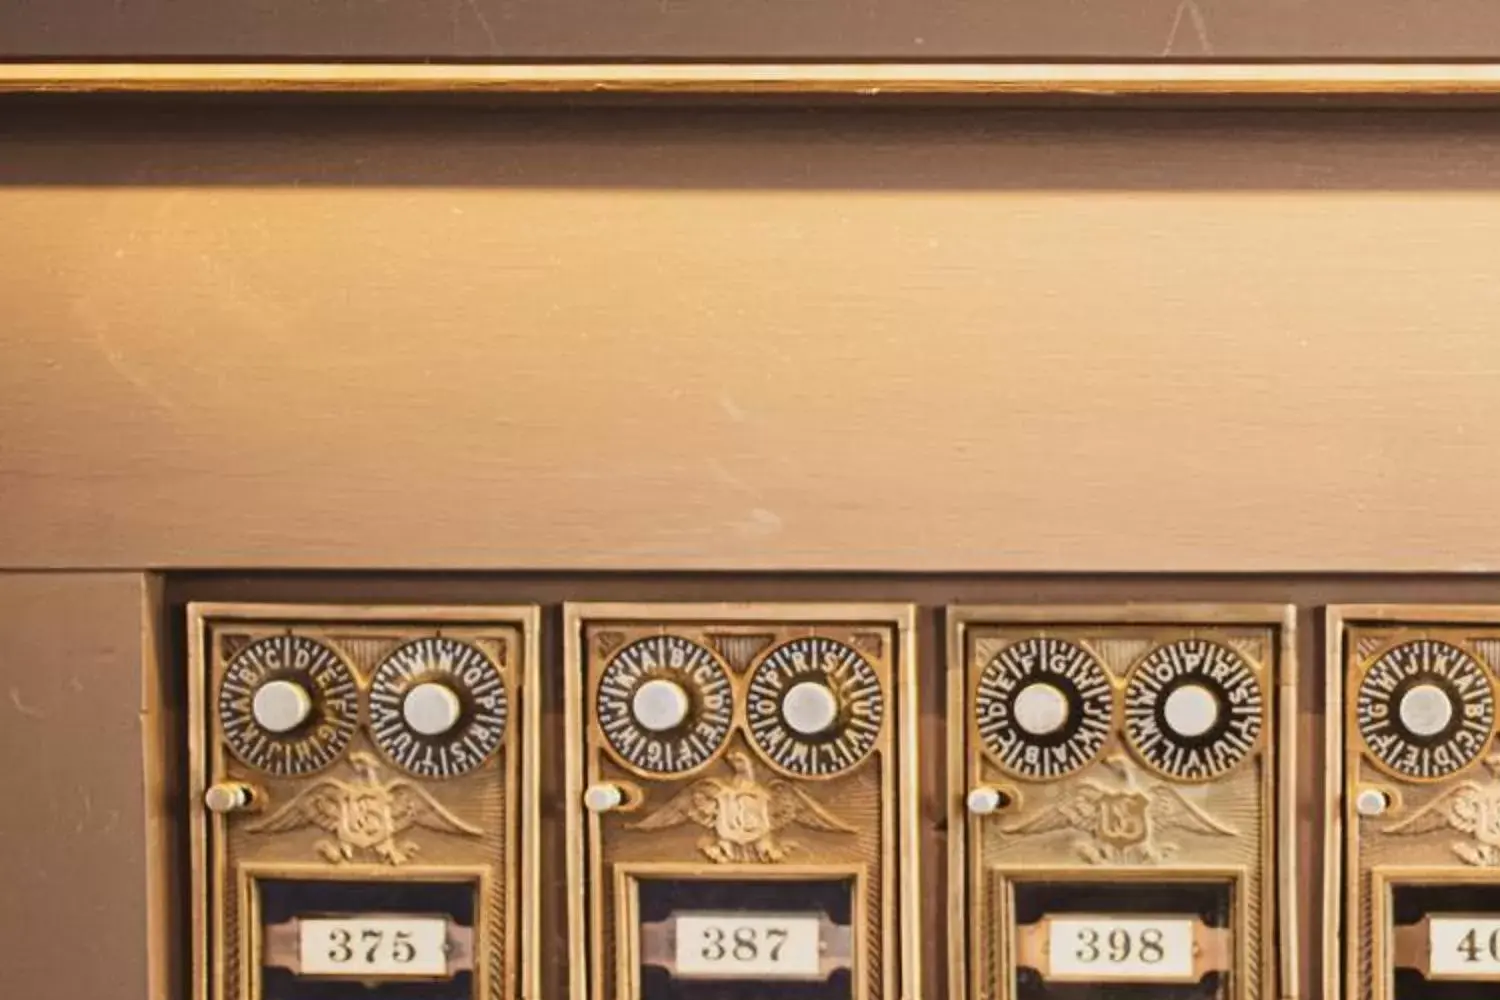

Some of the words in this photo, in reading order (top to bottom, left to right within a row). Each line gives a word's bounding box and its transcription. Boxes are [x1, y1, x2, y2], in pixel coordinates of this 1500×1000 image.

[265, 651, 281, 670] C
[294, 649, 310, 669] D
[639, 652, 657, 672] A
[669, 649, 685, 669] B
[791, 653, 809, 673] R
[821, 653, 838, 673] S
[1020, 655, 1036, 674] F
[1049, 654, 1069, 674] G
[1185, 656, 1200, 672] P
[1404, 655, 1419, 675] J
[1433, 655, 1448, 676] K
[327, 928, 418, 964] 375
[701, 928, 789, 963] 387
[1075, 929, 1166, 963] 398
